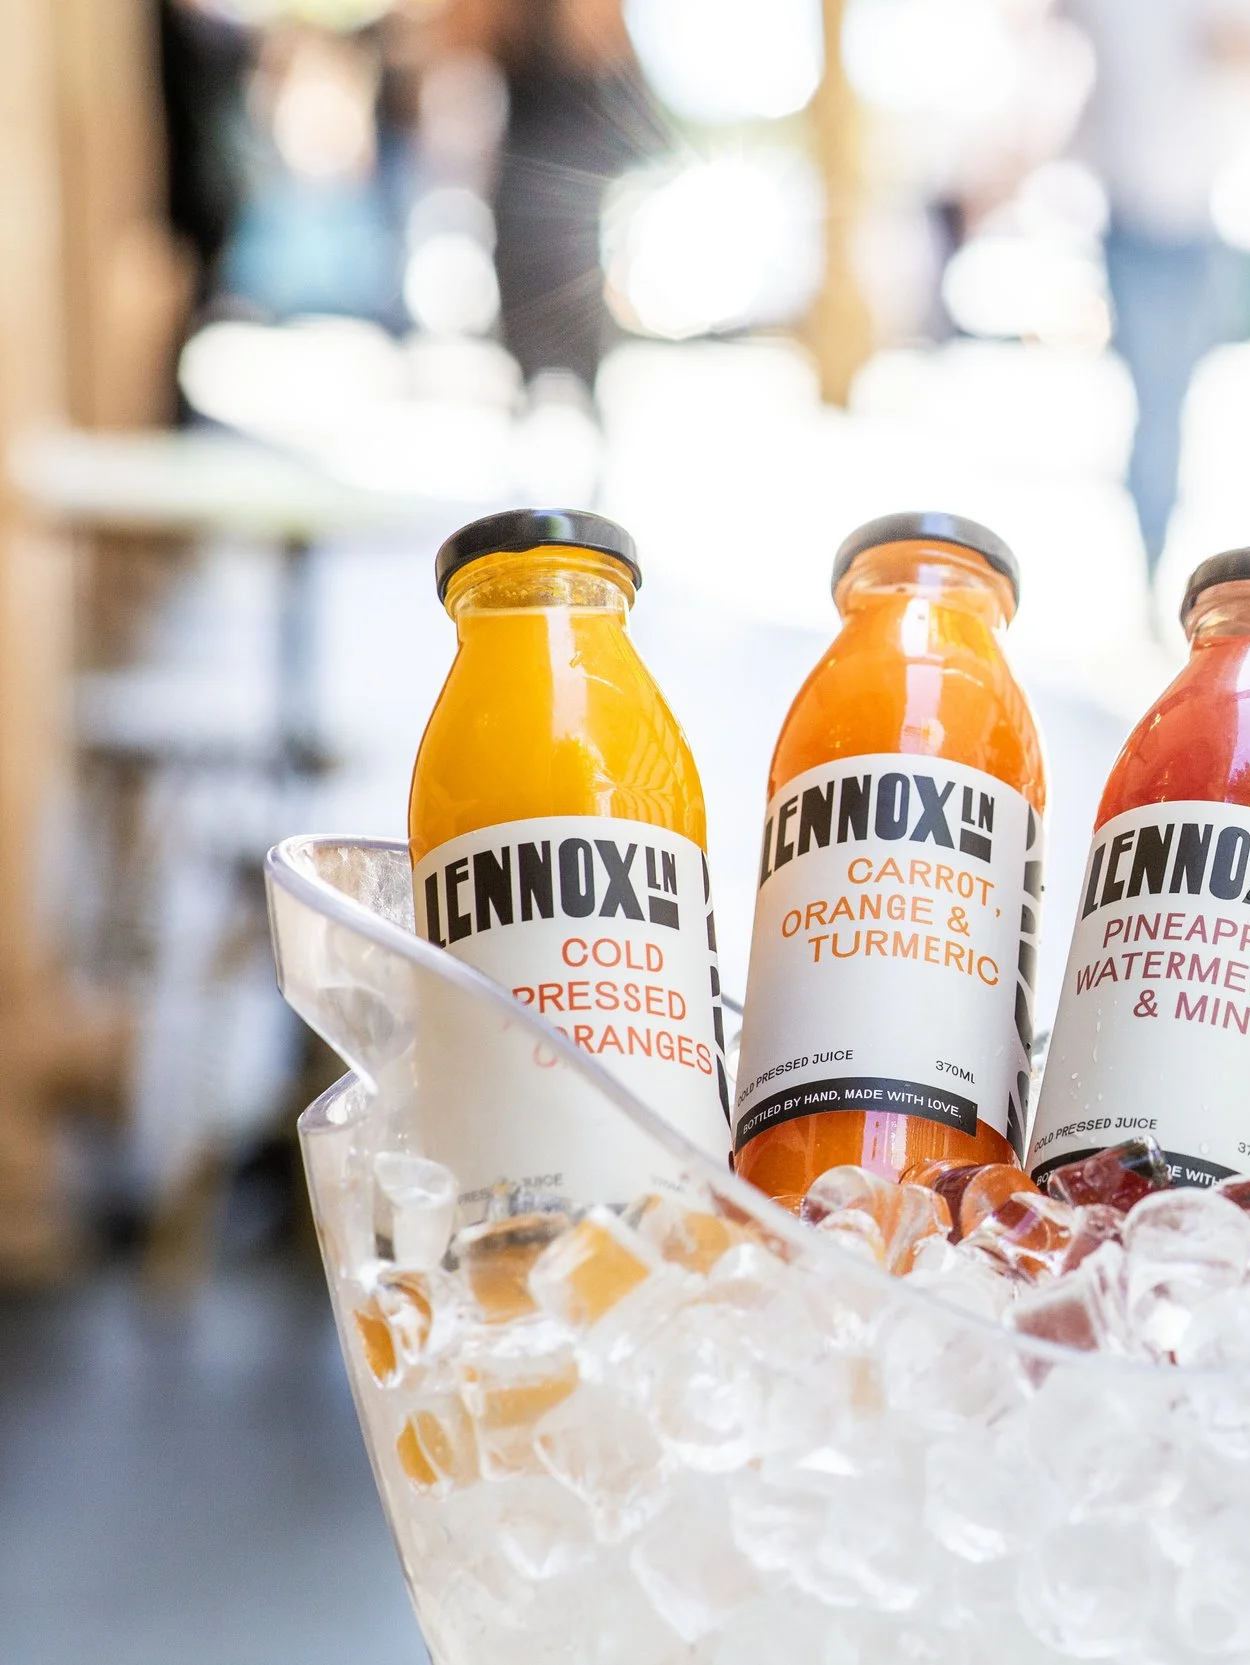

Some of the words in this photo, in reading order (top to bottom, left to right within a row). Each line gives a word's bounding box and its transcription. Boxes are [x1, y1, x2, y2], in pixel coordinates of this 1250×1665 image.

[760, 773, 955, 890] LENNOX
[961, 786, 995, 832] LN
[425, 838, 645, 949] LENNOX
[645, 846, 678, 896] LN
[847, 858, 1000, 917] CARROT,
[782, 894, 933, 938] ORANGE
[949, 906, 970, 936] &
[562, 938, 663, 973] COLD
[808, 930, 999, 986] TURMERIC
[512, 981, 686, 1020] PRESSED
[1133, 990, 1158, 1018] &
[534, 1024, 713, 1075] ORANGES
[756, 1057, 809, 1087] PRESSED
[812, 1050, 854, 1064] JUICE
[936, 1060, 975, 1084] 370ML
[743, 1104, 781, 1134] BOTTLED
[784, 1096, 801, 1111] BY
[804, 1090, 841, 1104] HAND,
[845, 1089, 883, 1099] MADE
[887, 1090, 924, 1106] WITH
[928, 1098, 962, 1118] LOVE.
[1034, 1132, 1054, 1153] COLD
[1055, 1118, 1111, 1139] PRESSED
[1115, 1117, 1158, 1130] JUICE
